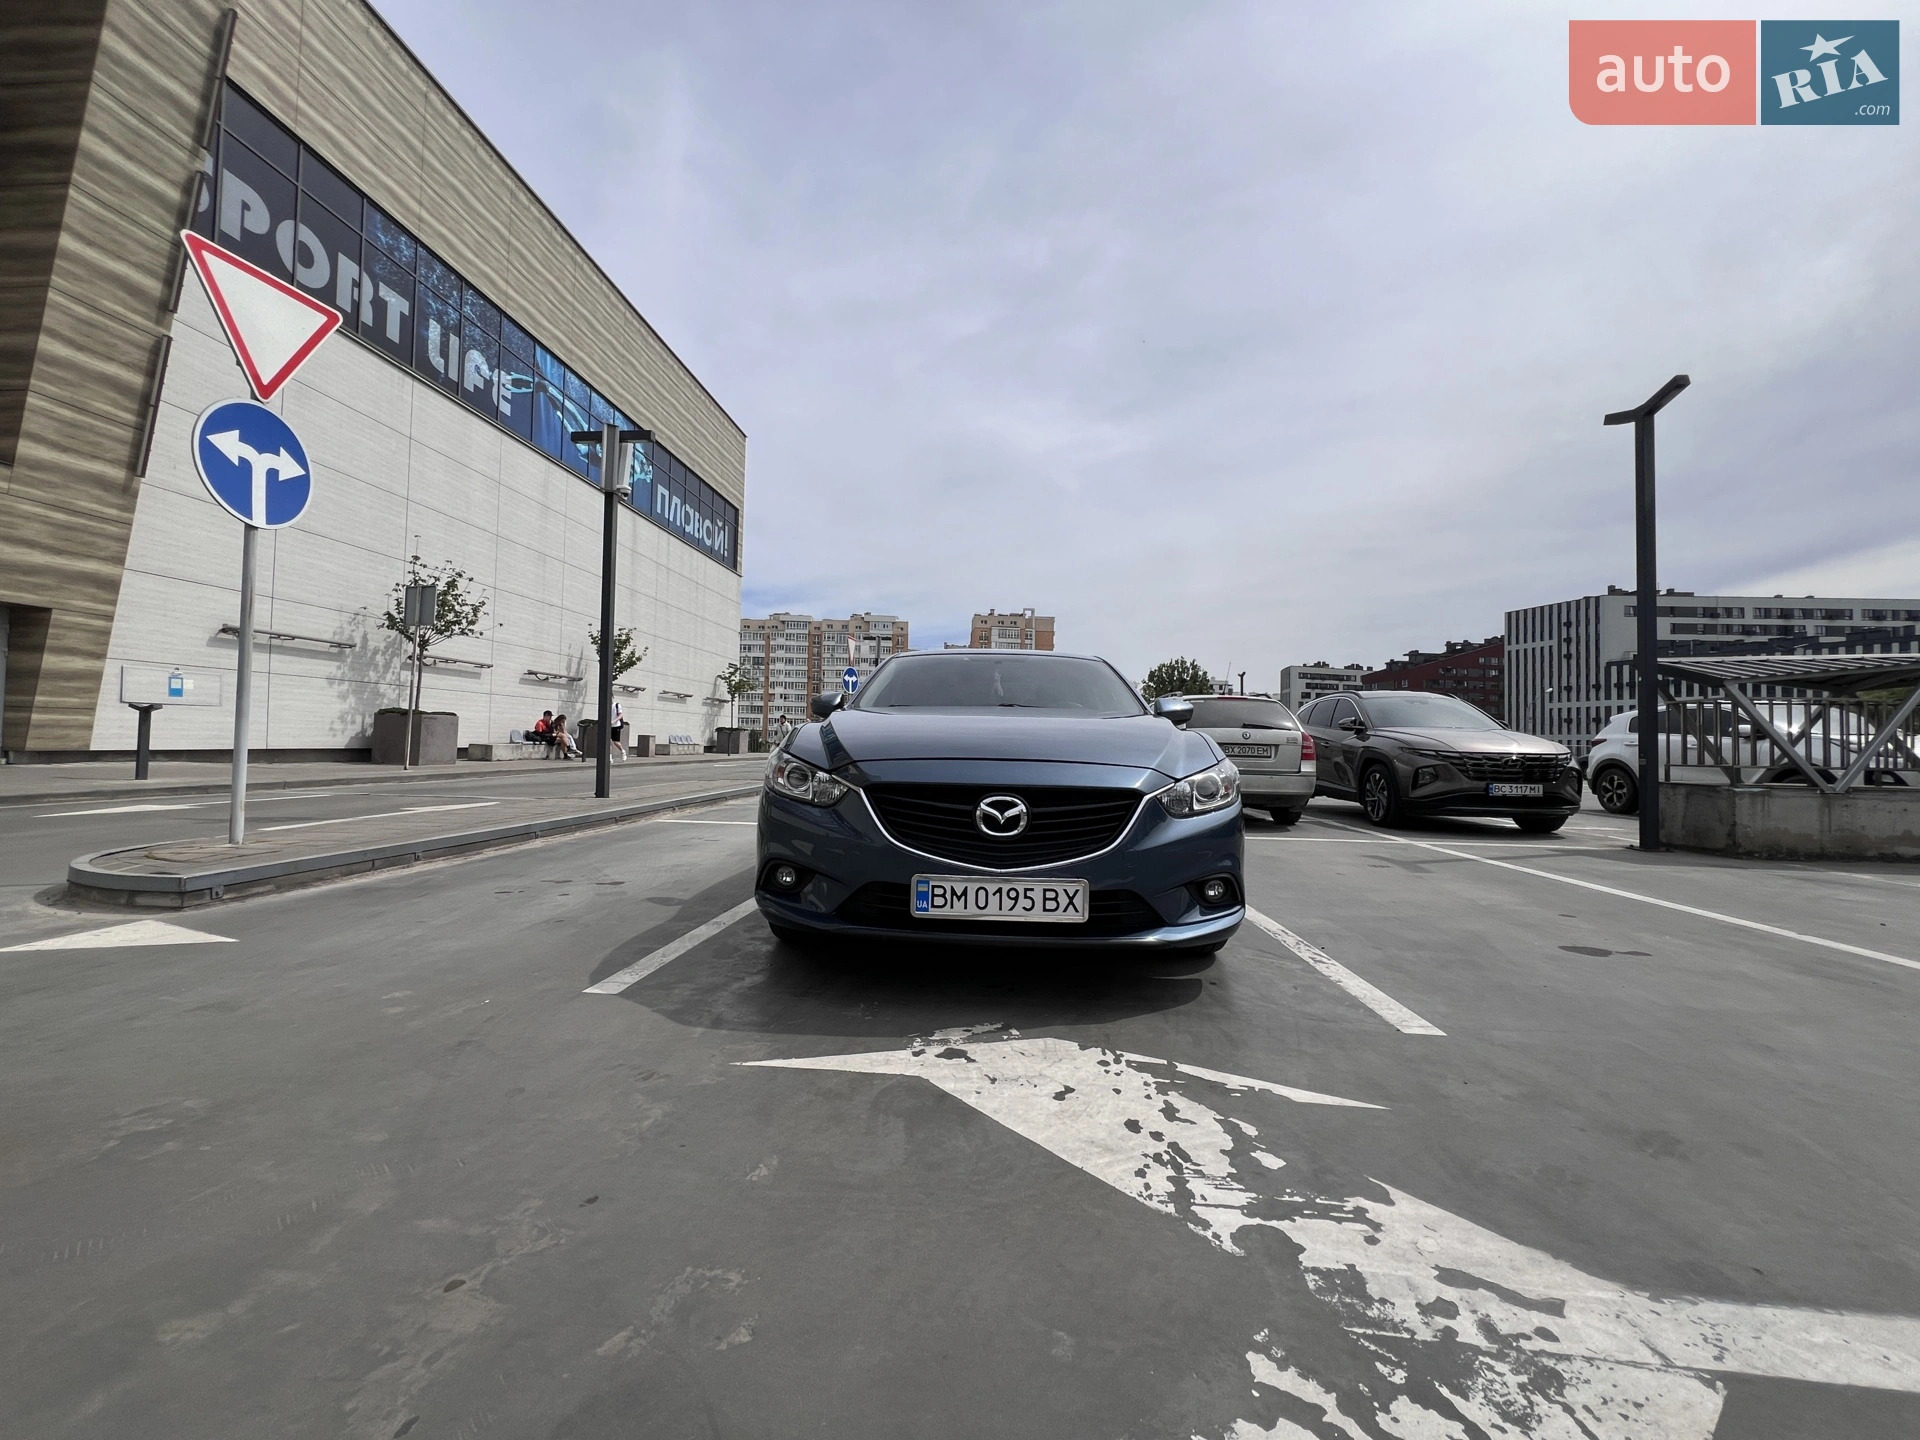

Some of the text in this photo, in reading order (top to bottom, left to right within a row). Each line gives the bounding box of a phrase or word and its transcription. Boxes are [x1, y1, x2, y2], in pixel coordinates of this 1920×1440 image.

[1237, 746, 1256, 755] 2070
[1256, 747, 1269, 755] EM
[930, 885, 1081, 914] BM 0195 BX
[916, 900, 928, 909] UA
